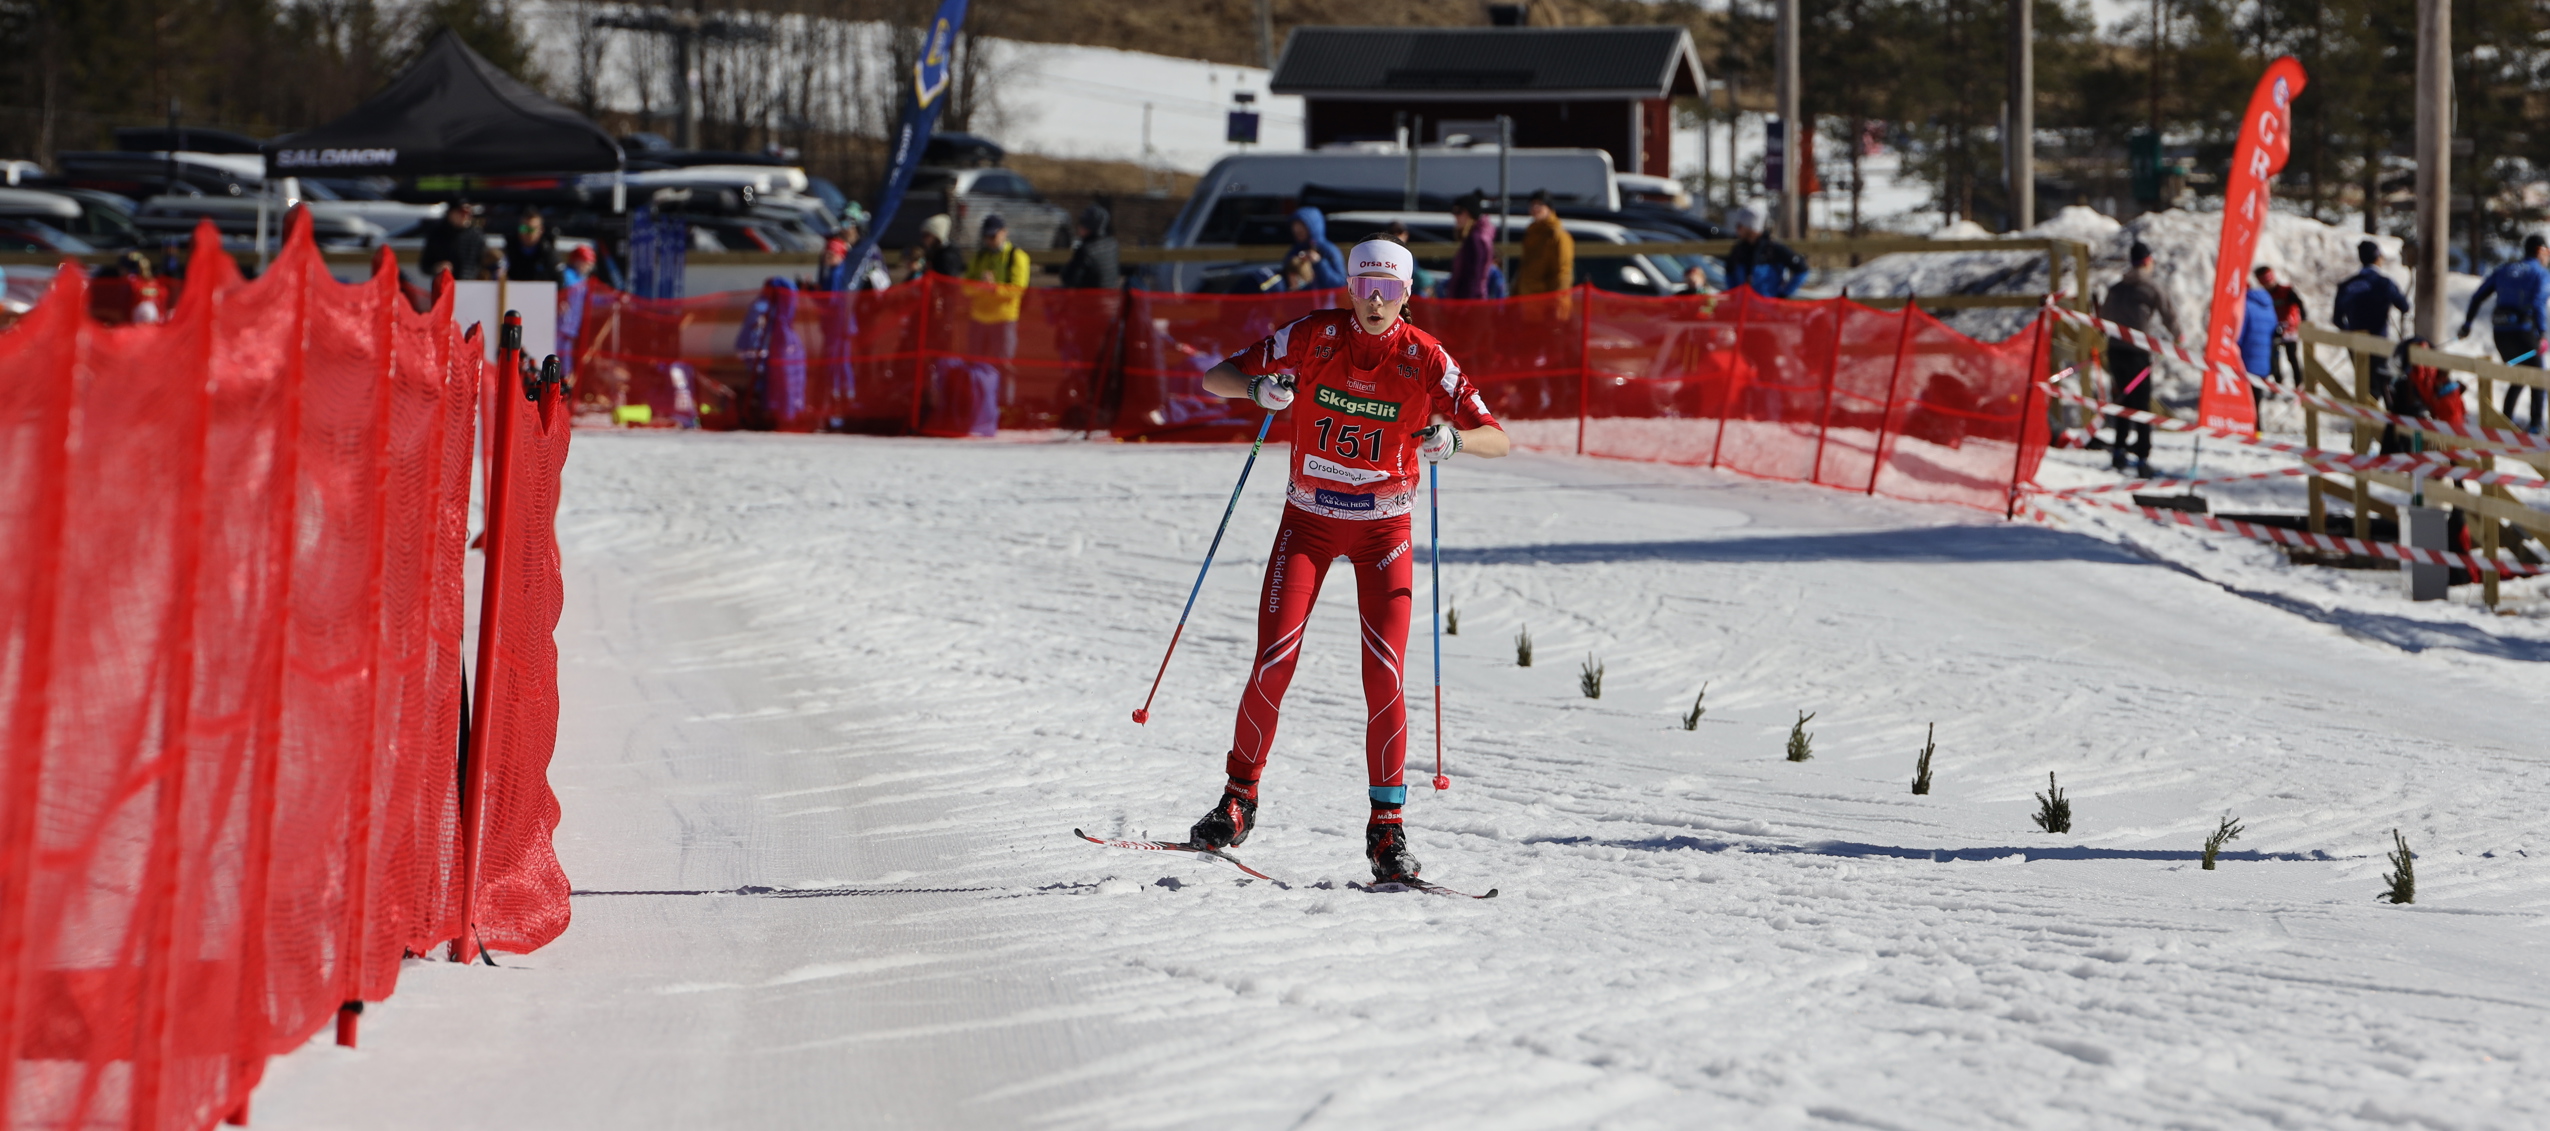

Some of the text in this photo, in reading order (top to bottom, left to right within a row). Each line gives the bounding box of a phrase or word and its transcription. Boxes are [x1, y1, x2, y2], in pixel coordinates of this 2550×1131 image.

[276, 149, 398, 168] SALOMON
[1385, 262, 1398, 271] SK
[1397, 364, 1420, 380] 151
[1346, 379, 1377, 392] rofiltextil
[1315, 416, 1385, 462] 151
[1376, 539, 1410, 571] TRIMTEX
[1268, 528, 1294, 614] Orsa Skidklubb
